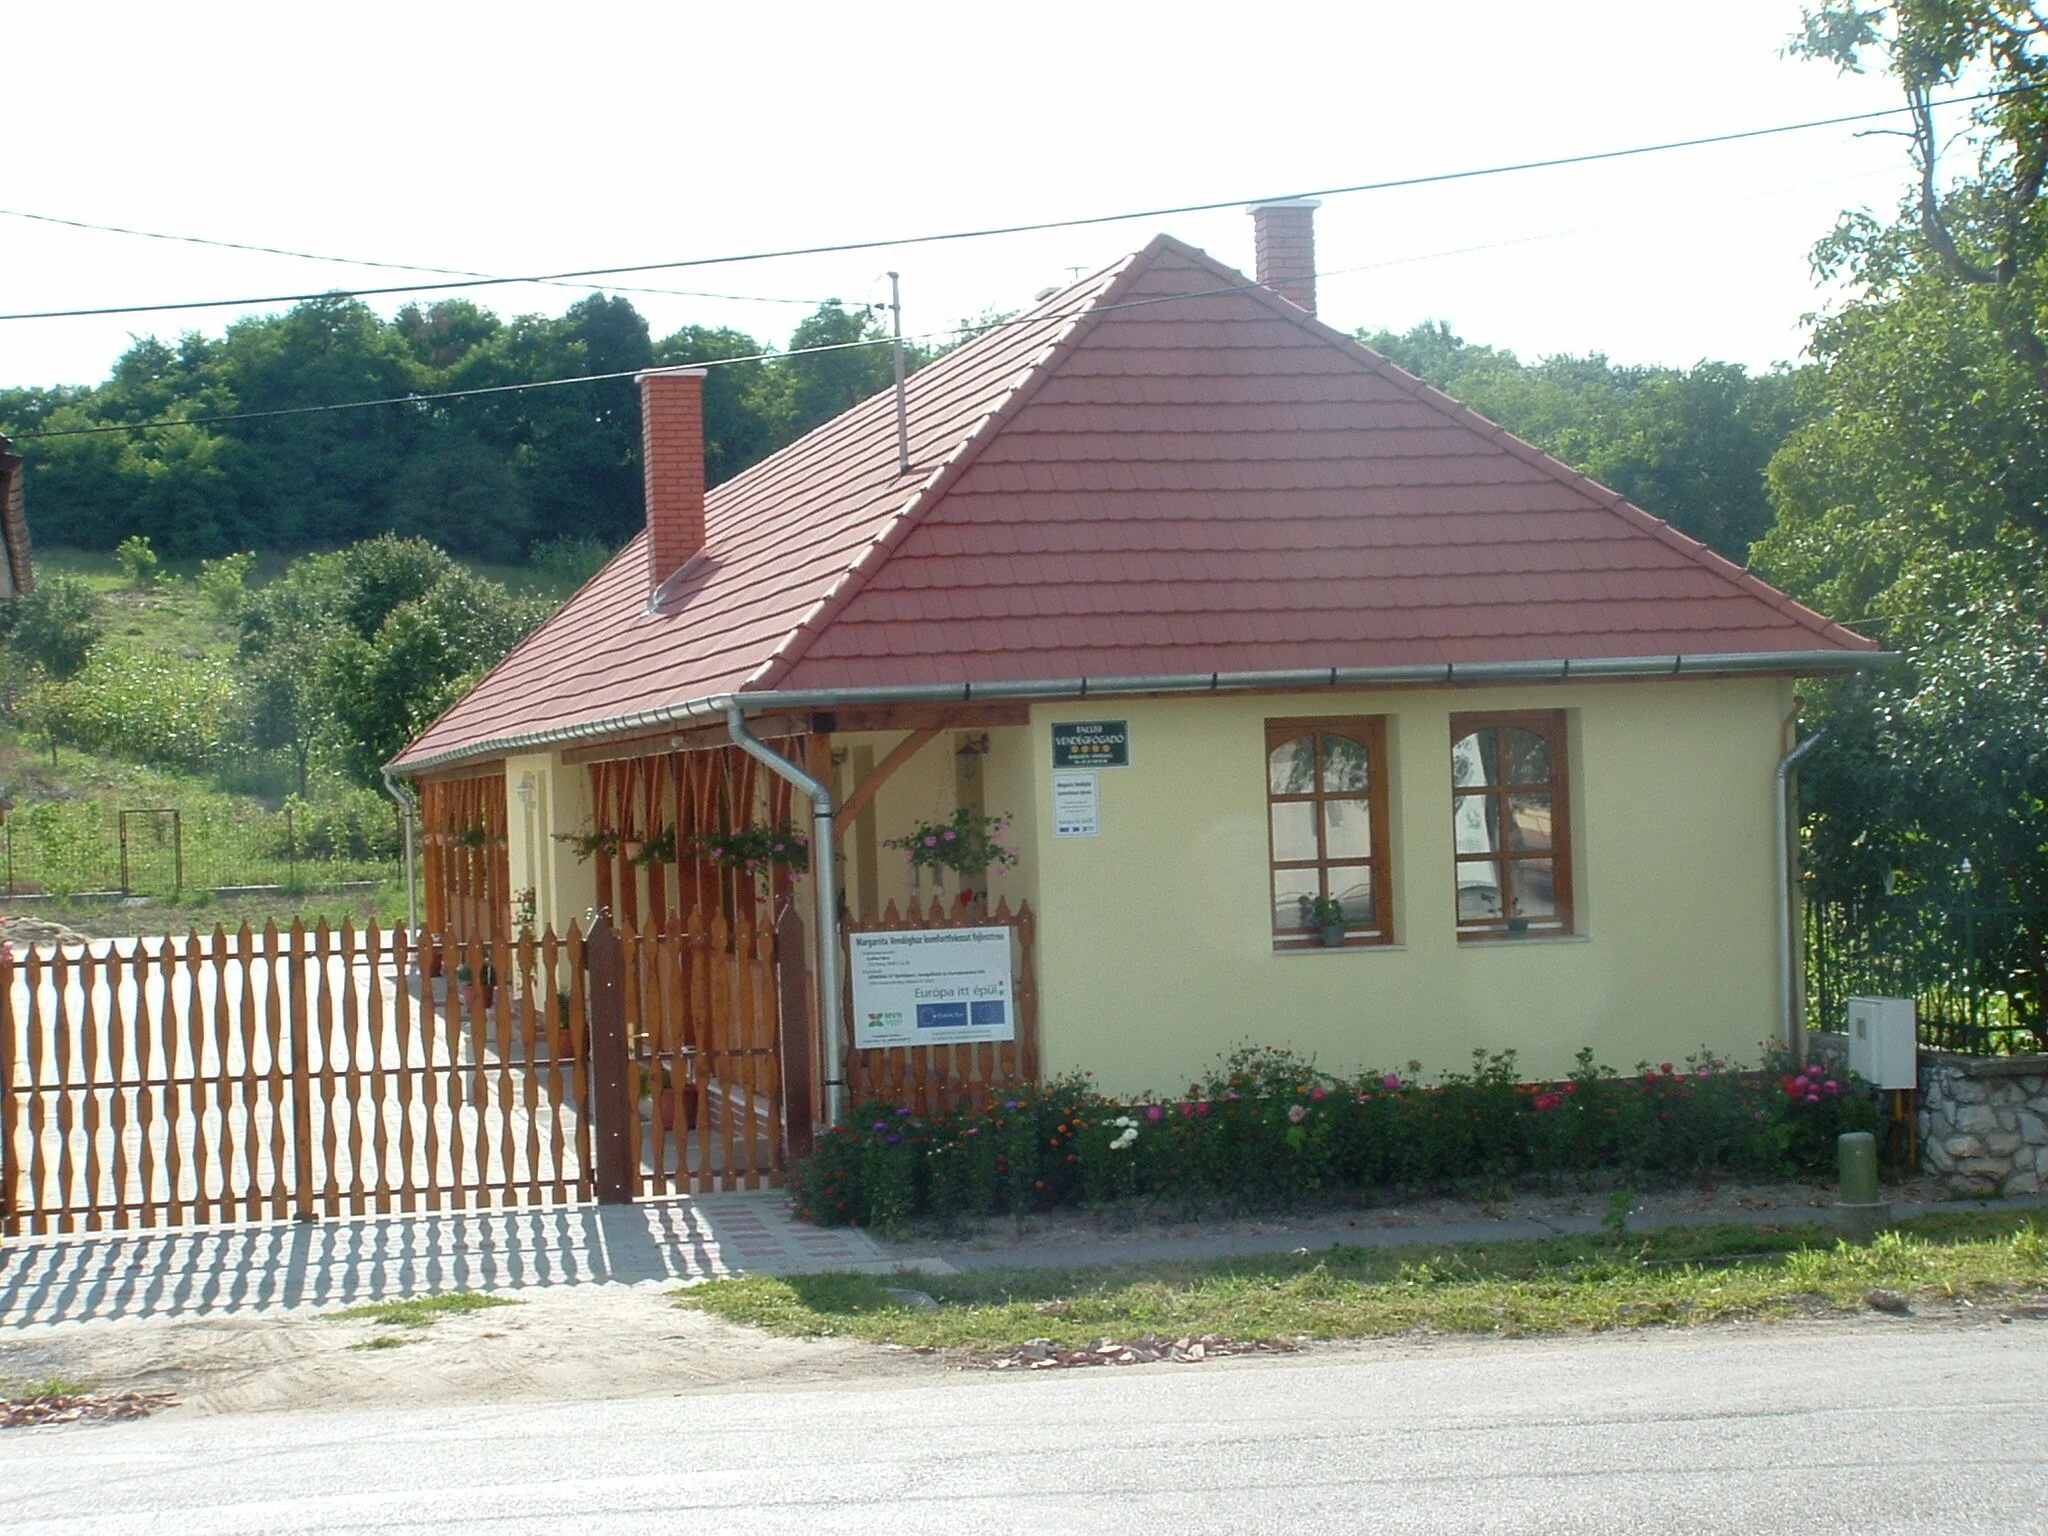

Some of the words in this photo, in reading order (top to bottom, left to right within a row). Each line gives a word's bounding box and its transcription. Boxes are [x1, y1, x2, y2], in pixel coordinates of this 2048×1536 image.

[1056, 732, 1124, 745] VENDÉGFOGADÓ
[914, 986, 954, 1000] Európa
[957, 985, 970, 997] itt
